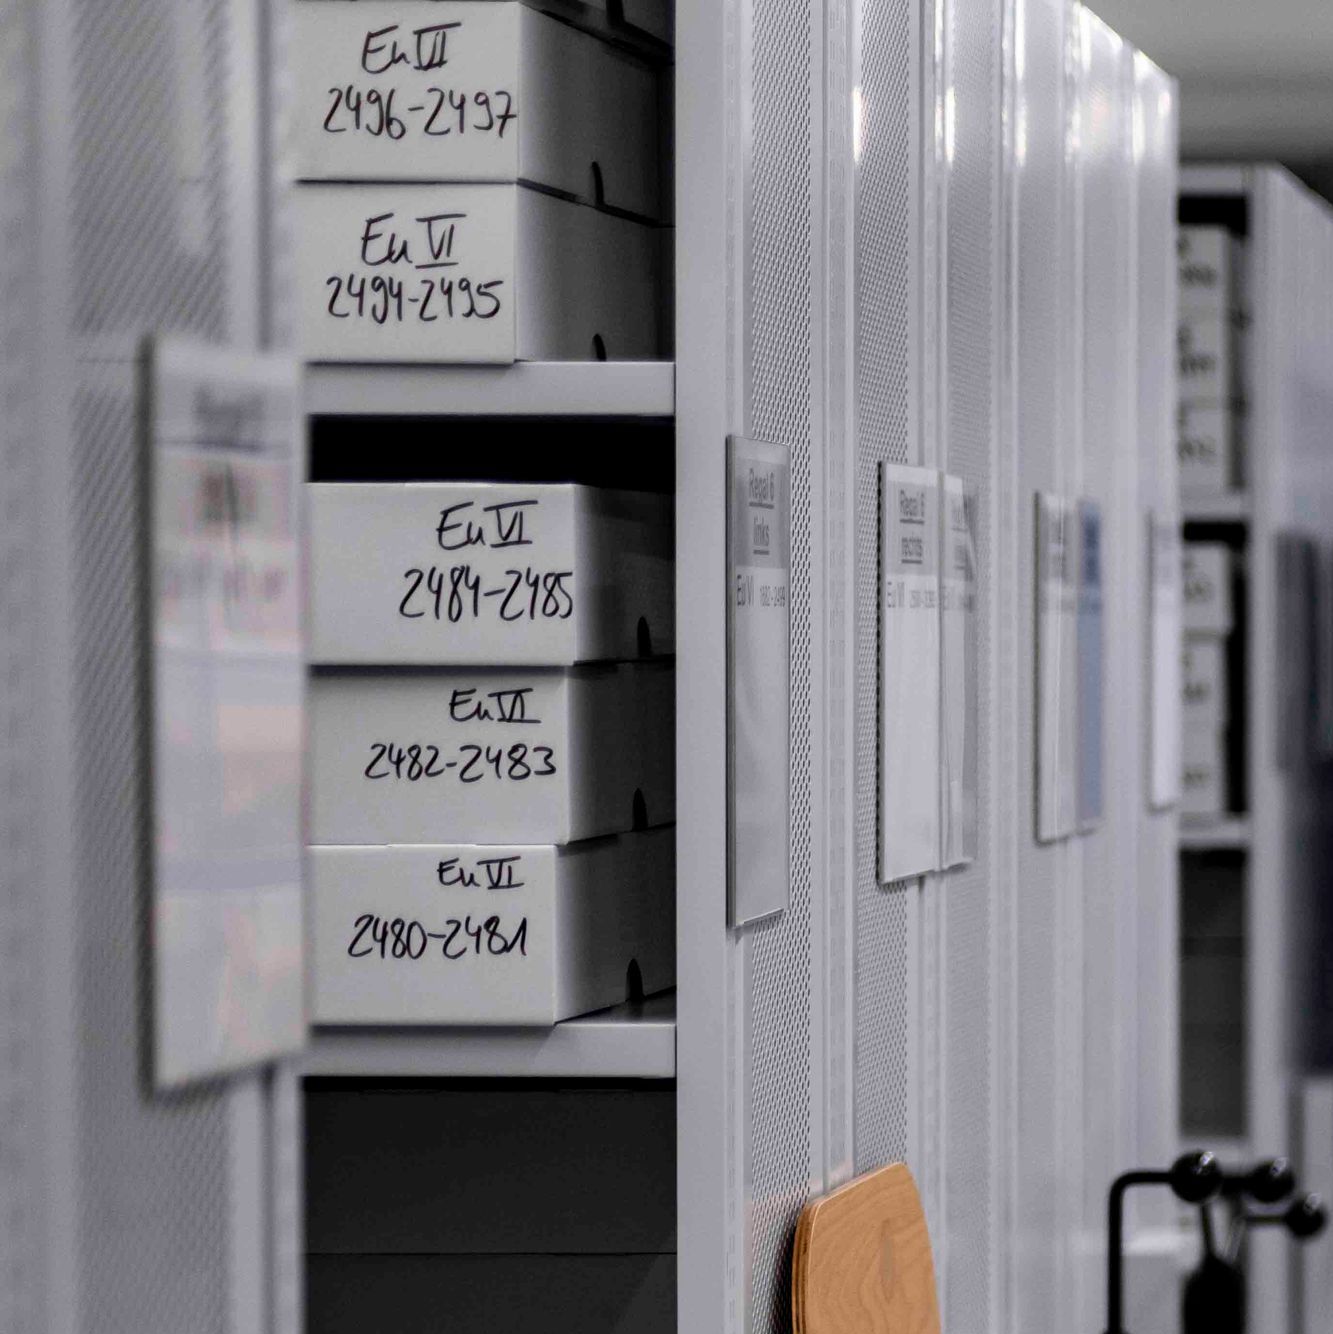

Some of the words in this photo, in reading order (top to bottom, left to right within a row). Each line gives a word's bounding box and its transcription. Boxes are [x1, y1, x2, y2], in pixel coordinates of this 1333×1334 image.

[324, 85, 516, 140] 2496-2497
[416, 214, 466, 269] VI
[327, 274, 503, 324] 2494-2495
[482, 500, 538, 548] VI
[399, 565, 572, 623] 2484-2485
[489, 688, 540, 723] VI
[365, 743, 556, 783] 2482-2483
[482, 856, 524, 890] VI
[348, 914, 527, 959] 2480-2481
